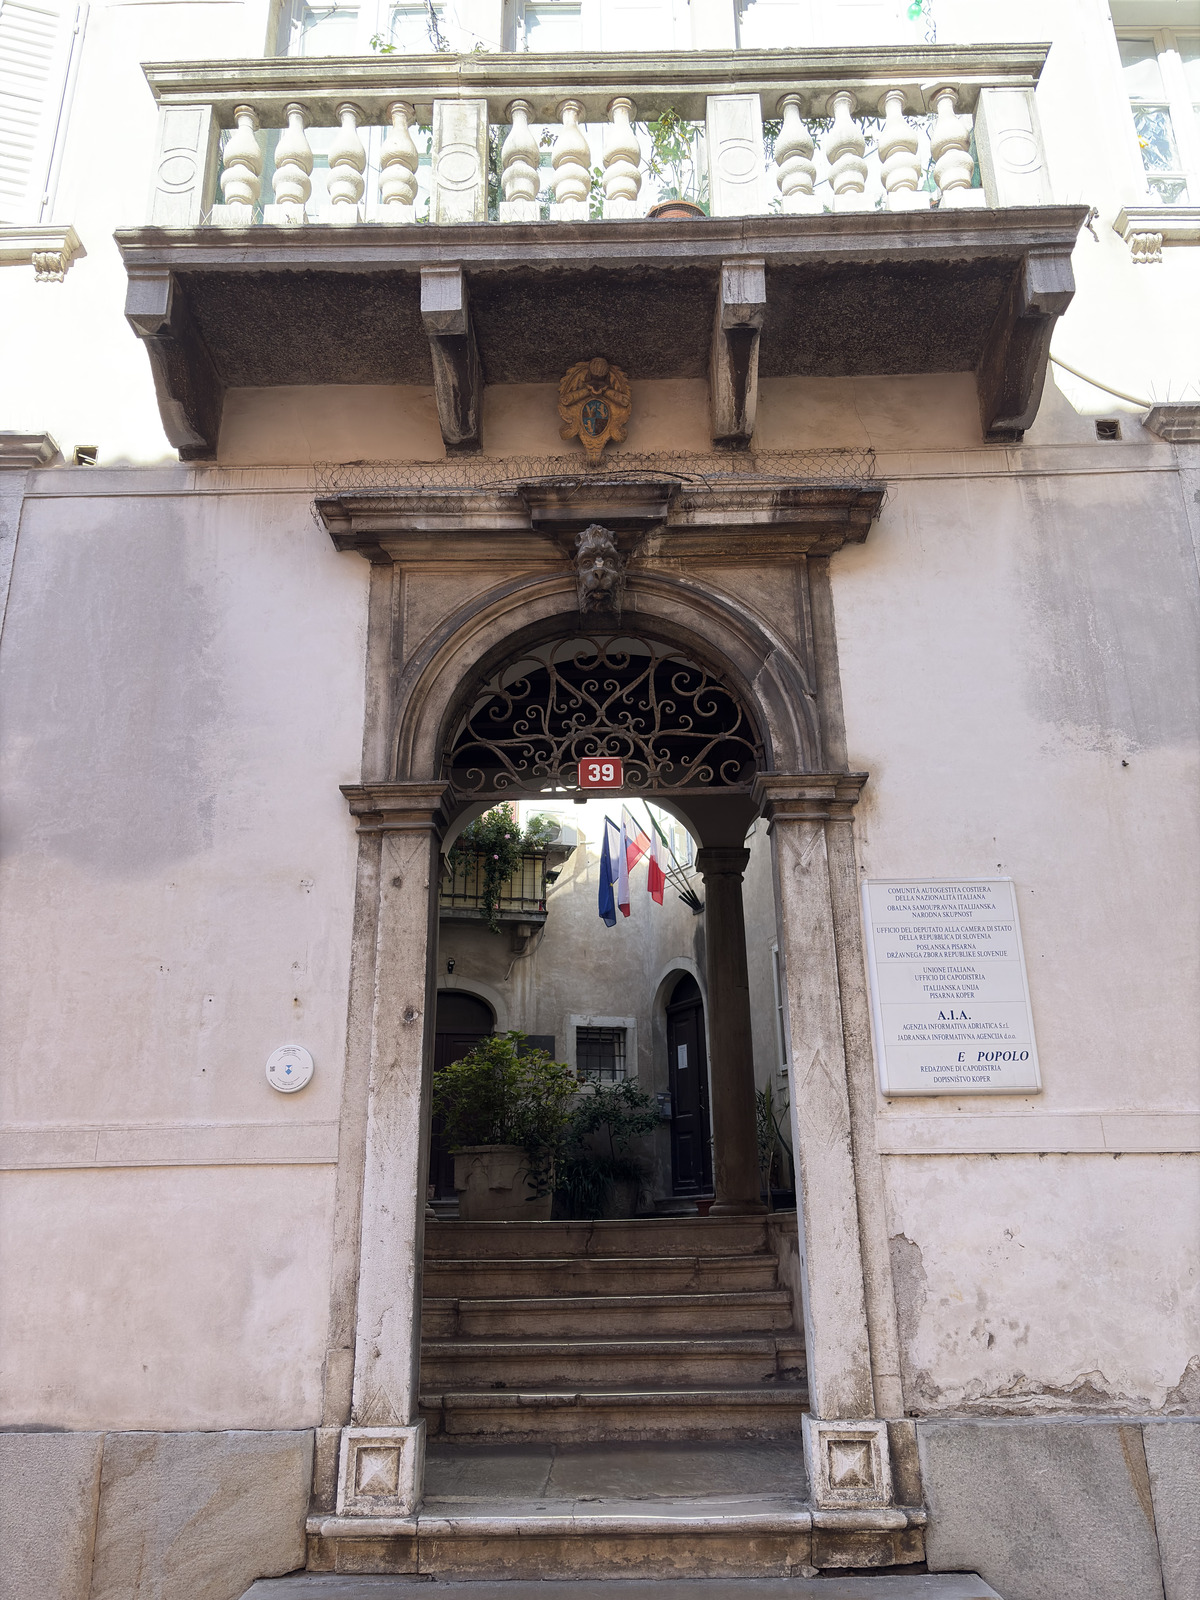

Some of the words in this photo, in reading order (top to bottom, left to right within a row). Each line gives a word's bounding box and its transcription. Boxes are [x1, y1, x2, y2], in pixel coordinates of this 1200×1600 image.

[588, 763, 614, 782] 39
[938, 1010, 971, 1020] A.I.A.
[958, 1052, 965, 1062] E
[977, 1051, 1029, 1061] POPOLO
